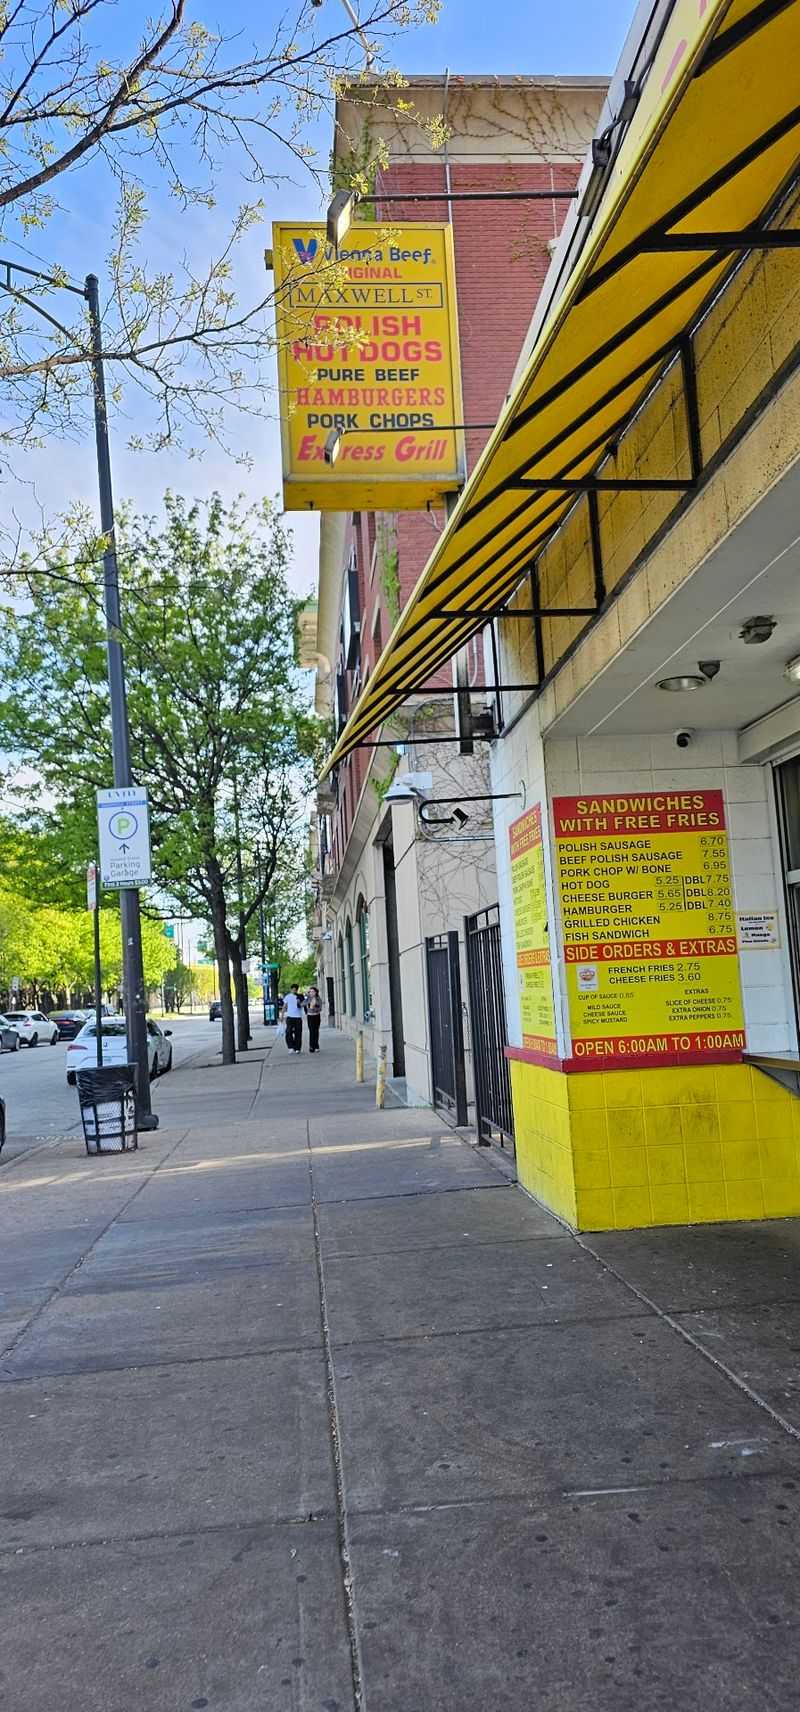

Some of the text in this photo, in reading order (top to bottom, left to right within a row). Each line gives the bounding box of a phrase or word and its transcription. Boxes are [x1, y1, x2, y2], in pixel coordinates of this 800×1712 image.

[390, 247, 431, 264] Beef
[297, 288, 432, 304] MAXWELL ST.
[360, 341, 442, 362] DOGS
[318, 368, 420, 382] PURE BEEF
[296, 388, 445, 406] HAMBURGERS
[308, 412, 434, 428] PORK CHOPS
[297, 435, 448, 462] Exress Grill
[576, 794, 704, 815] SANDWICHES
[118, 816, 130, 834] P
[559, 812, 720, 832] WITH FREE FRIES
[558, 836, 724, 852] POLISH SAUSAGE 6.70
[560, 849, 726, 865] BEEF POLISH SAUSAGE 7.55
[110, 862, 140, 870] Parking
[110, 870, 138, 878] Garage
[560, 862, 726, 878] PORK CHOP W/ BONE 6.95
[562, 874, 728, 890] HOT DOG 5.25 DBL 7.75
[562, 892, 605, 904] CHEESE
[608, 890, 652, 902] BURGER
[658, 889, 680, 898] 5.65
[686, 888, 706, 897] DBL
[564, 904, 632, 916] HAMBURGER
[660, 902, 682, 911] 5.25
[688, 901, 708, 910] DBL
[564, 912, 732, 928] GRILLED CHICKEN 8.75
[566, 932, 589, 941] FISH
[592, 930, 650, 940] SANDWICH
[566, 946, 599, 961] SIDE
[603, 942, 661, 959] ORDERS
[667, 942, 676, 956] &
[679, 938, 736, 955] EXTRAS
[608, 962, 700, 974] FRENCH FRIES 2.75
[609, 972, 700, 985] CHEESE FRIES 3.60
[574, 1040, 614, 1057] OPEN
[618, 1037, 668, 1054] 6:00AM
[672, 1036, 691, 1050] TO
[695, 1033, 744, 1050] 1:00AM
